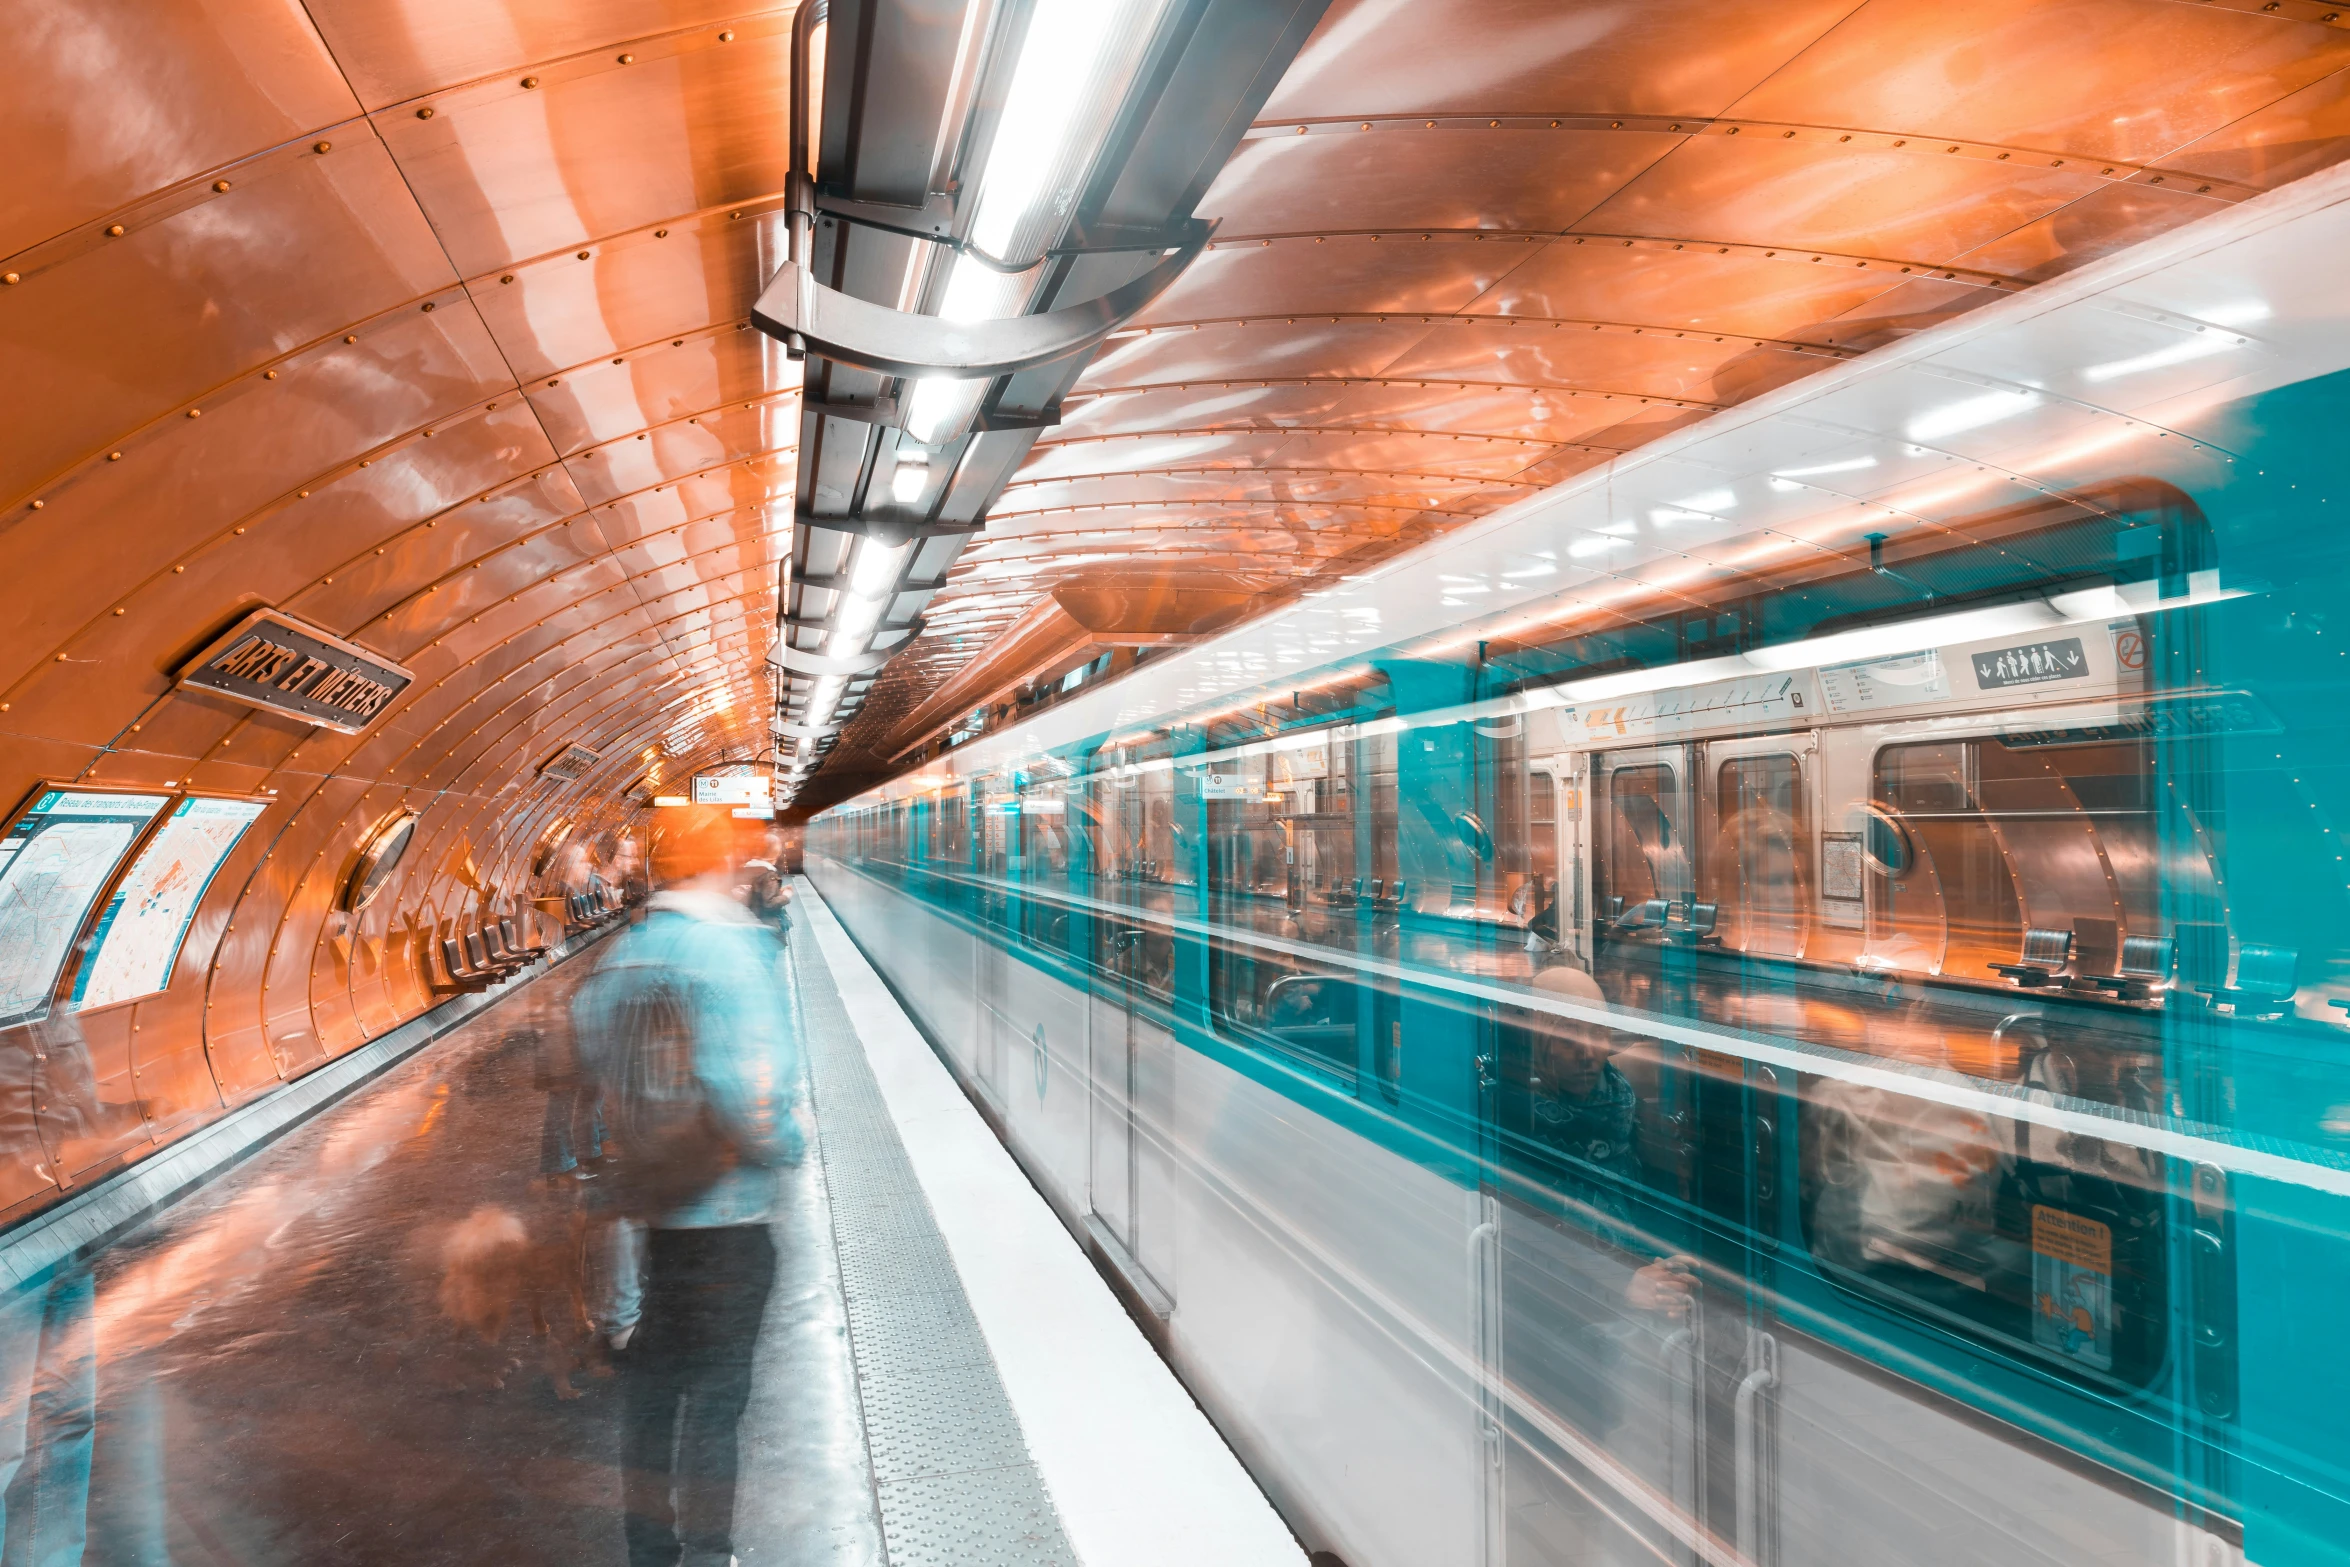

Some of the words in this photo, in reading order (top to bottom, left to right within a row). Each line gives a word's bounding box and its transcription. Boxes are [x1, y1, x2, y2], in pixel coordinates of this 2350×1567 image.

[211, 635, 298, 684] ARTS
[274, 655, 328, 694] ET
[304, 666, 393, 717] MÉTIERS
[1204, 786, 1226, 794] Châtelet
[2038, 1210, 2097, 1238] Attention
